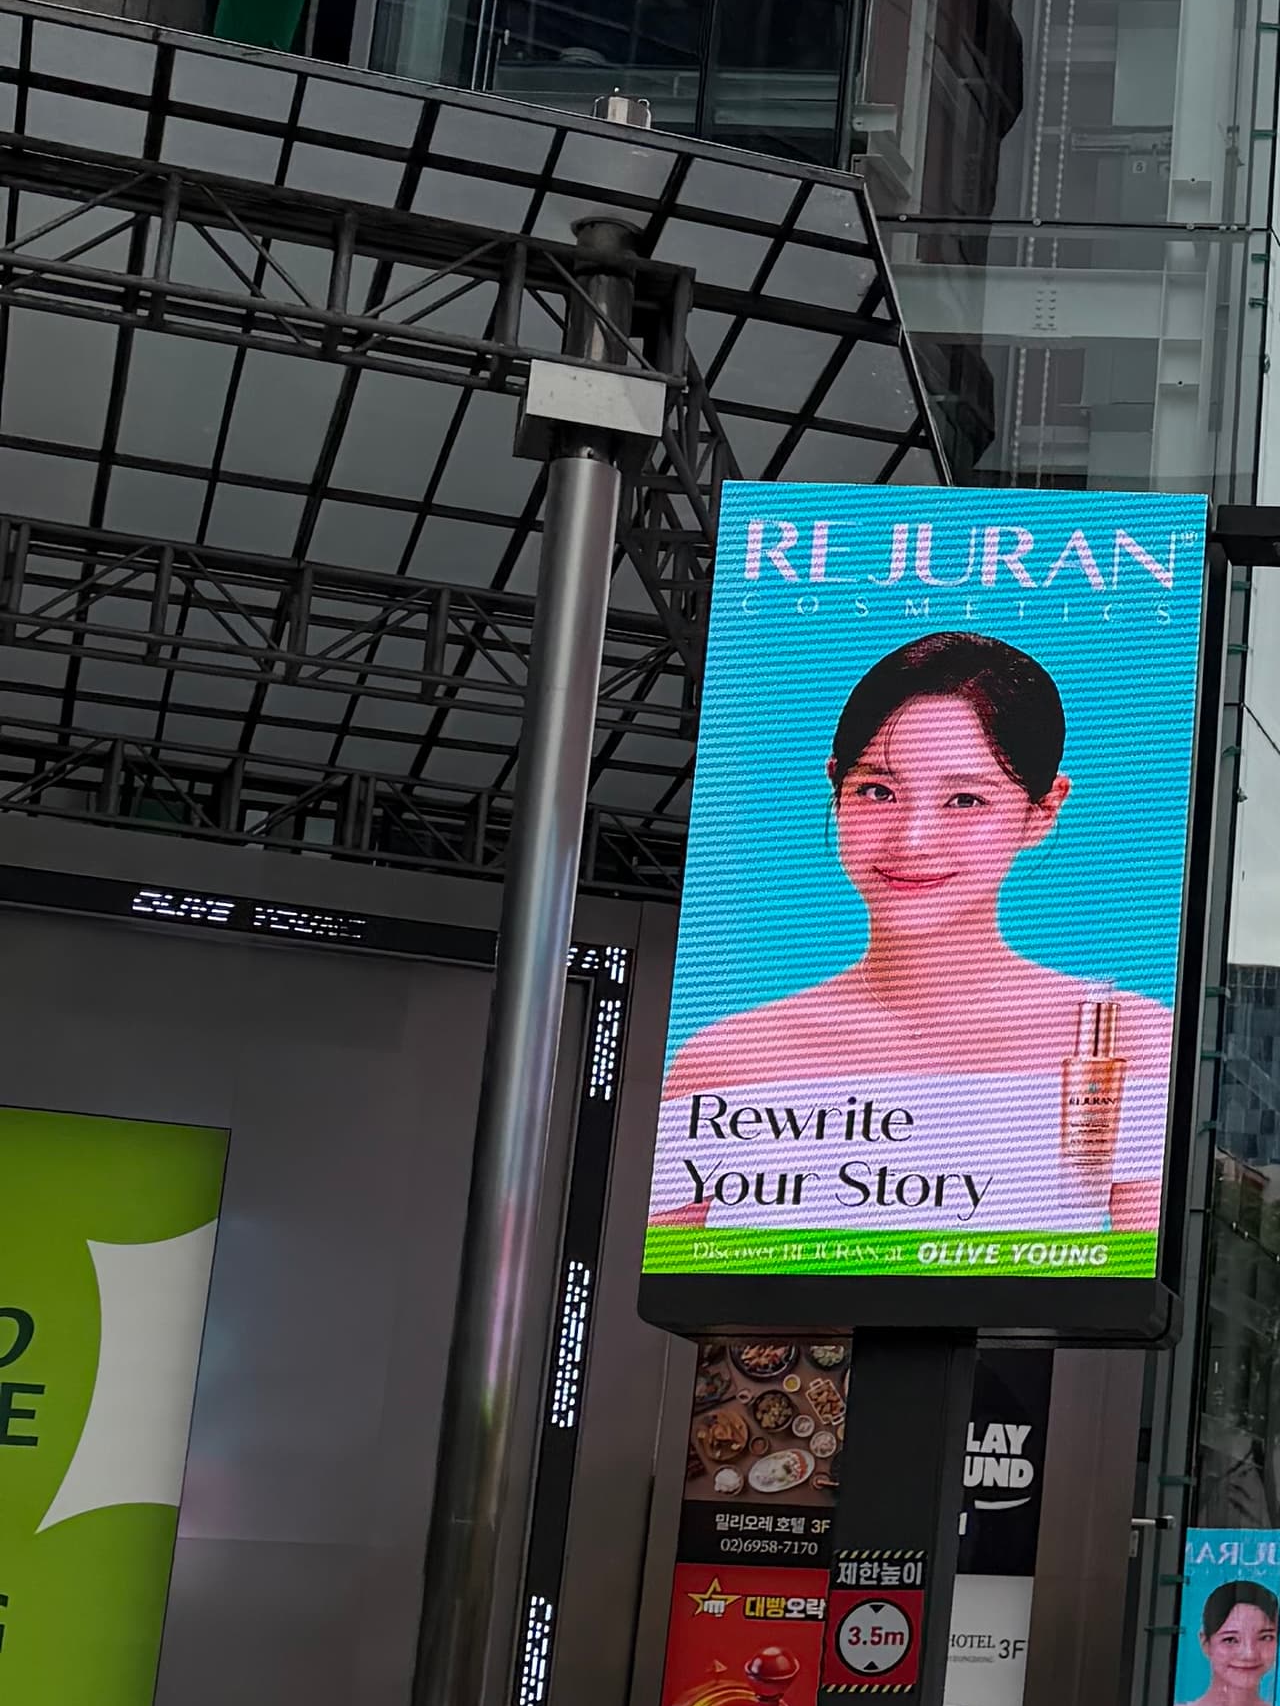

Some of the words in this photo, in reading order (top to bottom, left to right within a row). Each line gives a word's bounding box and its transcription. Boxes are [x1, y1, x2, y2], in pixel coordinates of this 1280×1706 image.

[685, 1094, 915, 1143] Rewrite
[683, 1159, 822, 1209] Your
[835, 1160, 994, 1222] Story
[917, 1242, 1000, 1265] OLIVE
[1010, 1243, 1110, 1266] YOUNG
[715, 1513, 773, 1532] 밀리오레
[775, 1516, 806, 1534] 호텔
[811, 1519, 831, 1533] 3F
[720, 1537, 818, 1556] 02)6958-7170
[836, 1560, 923, 1586] 제한높이
[847, 1625, 905, 1646] 3.5m
[998, 1638, 1026, 1660] 3F
